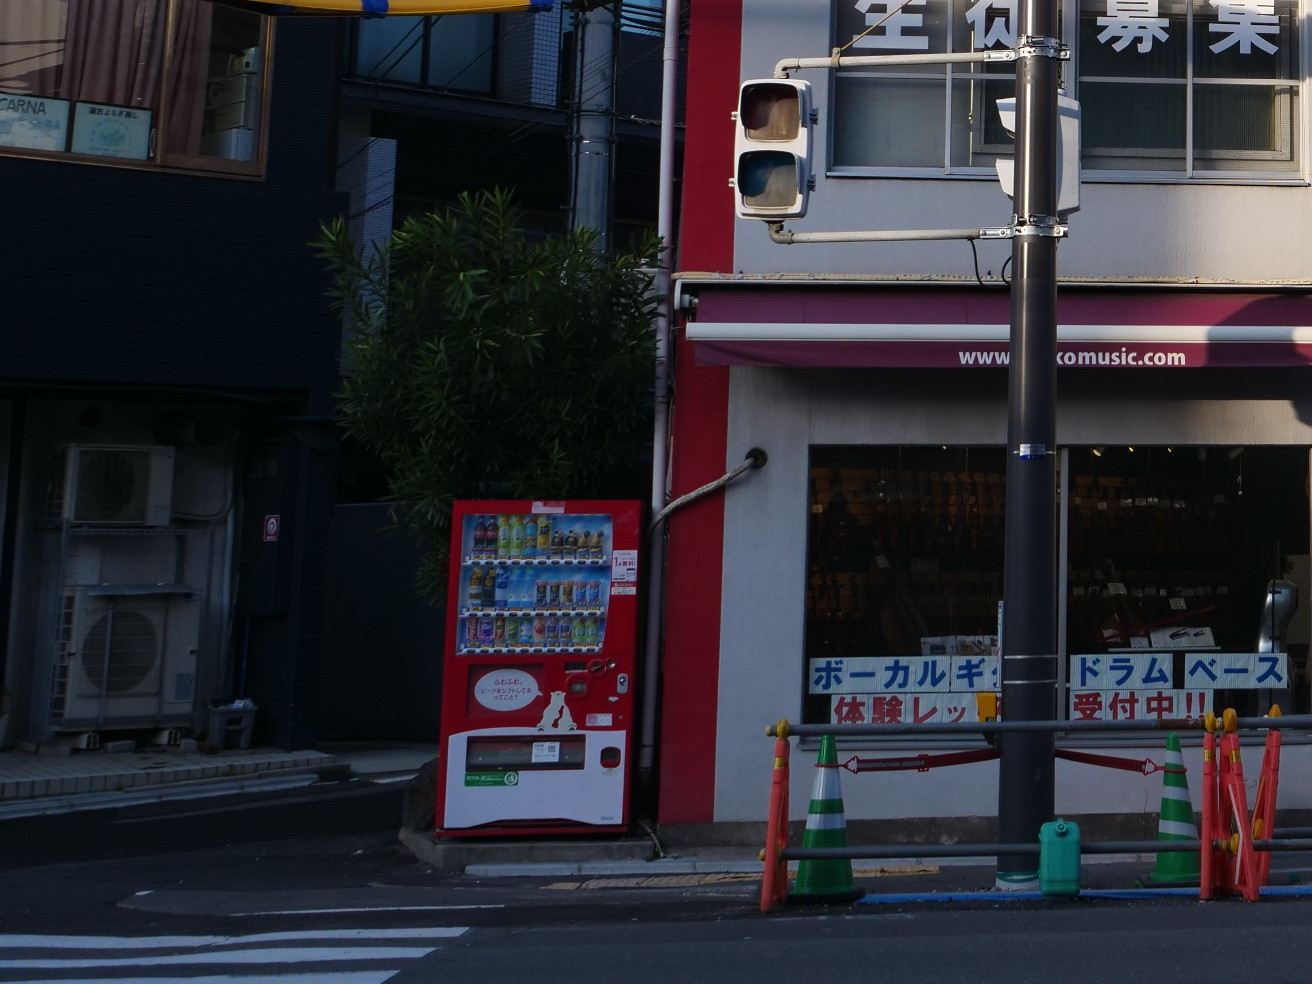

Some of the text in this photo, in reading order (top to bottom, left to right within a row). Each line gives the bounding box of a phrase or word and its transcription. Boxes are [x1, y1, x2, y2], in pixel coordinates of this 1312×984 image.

[813, 659, 947, 690] ボーカル
[1078, 657, 1171, 686] ドラム
[1187, 655, 1284, 685] ベース
